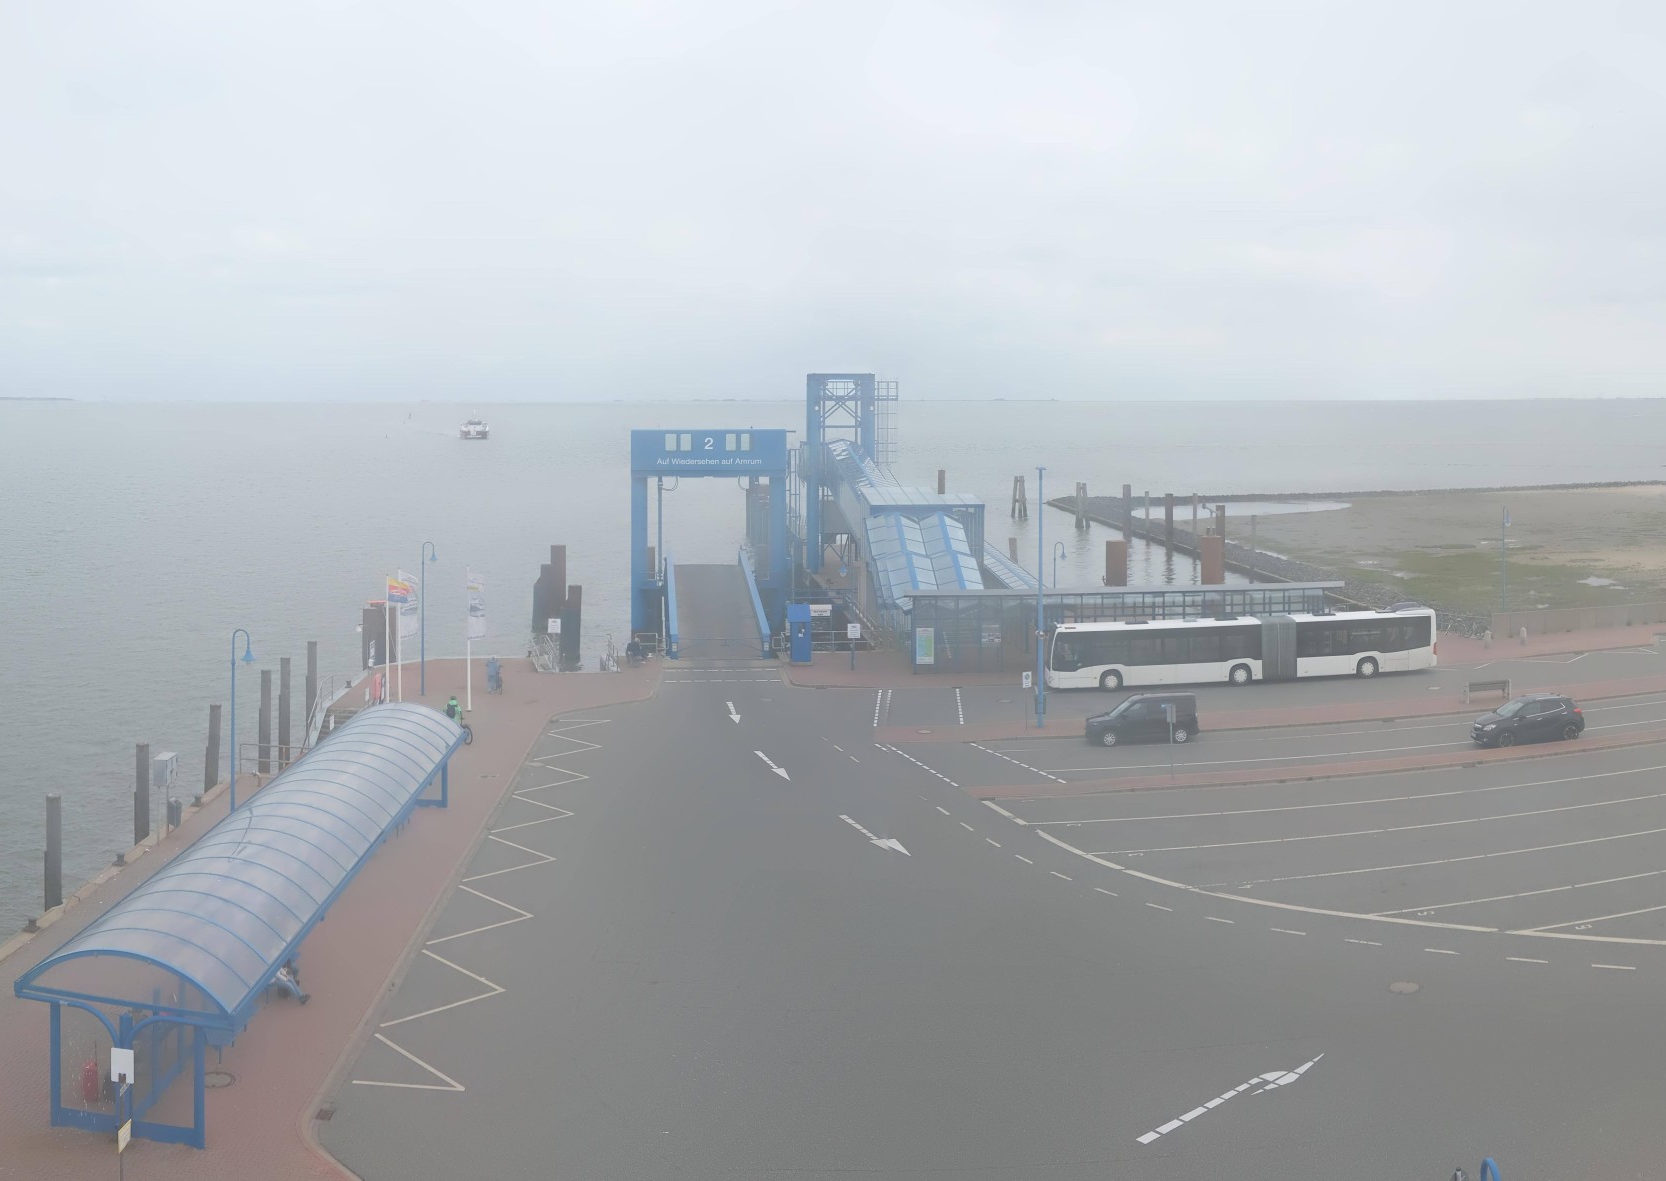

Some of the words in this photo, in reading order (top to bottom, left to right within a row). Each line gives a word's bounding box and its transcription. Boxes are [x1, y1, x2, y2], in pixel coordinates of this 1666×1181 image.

[704, 437, 714, 450] 2
[656, 457, 670, 465] Auf
[671, 457, 720, 465] Wiedersehen
